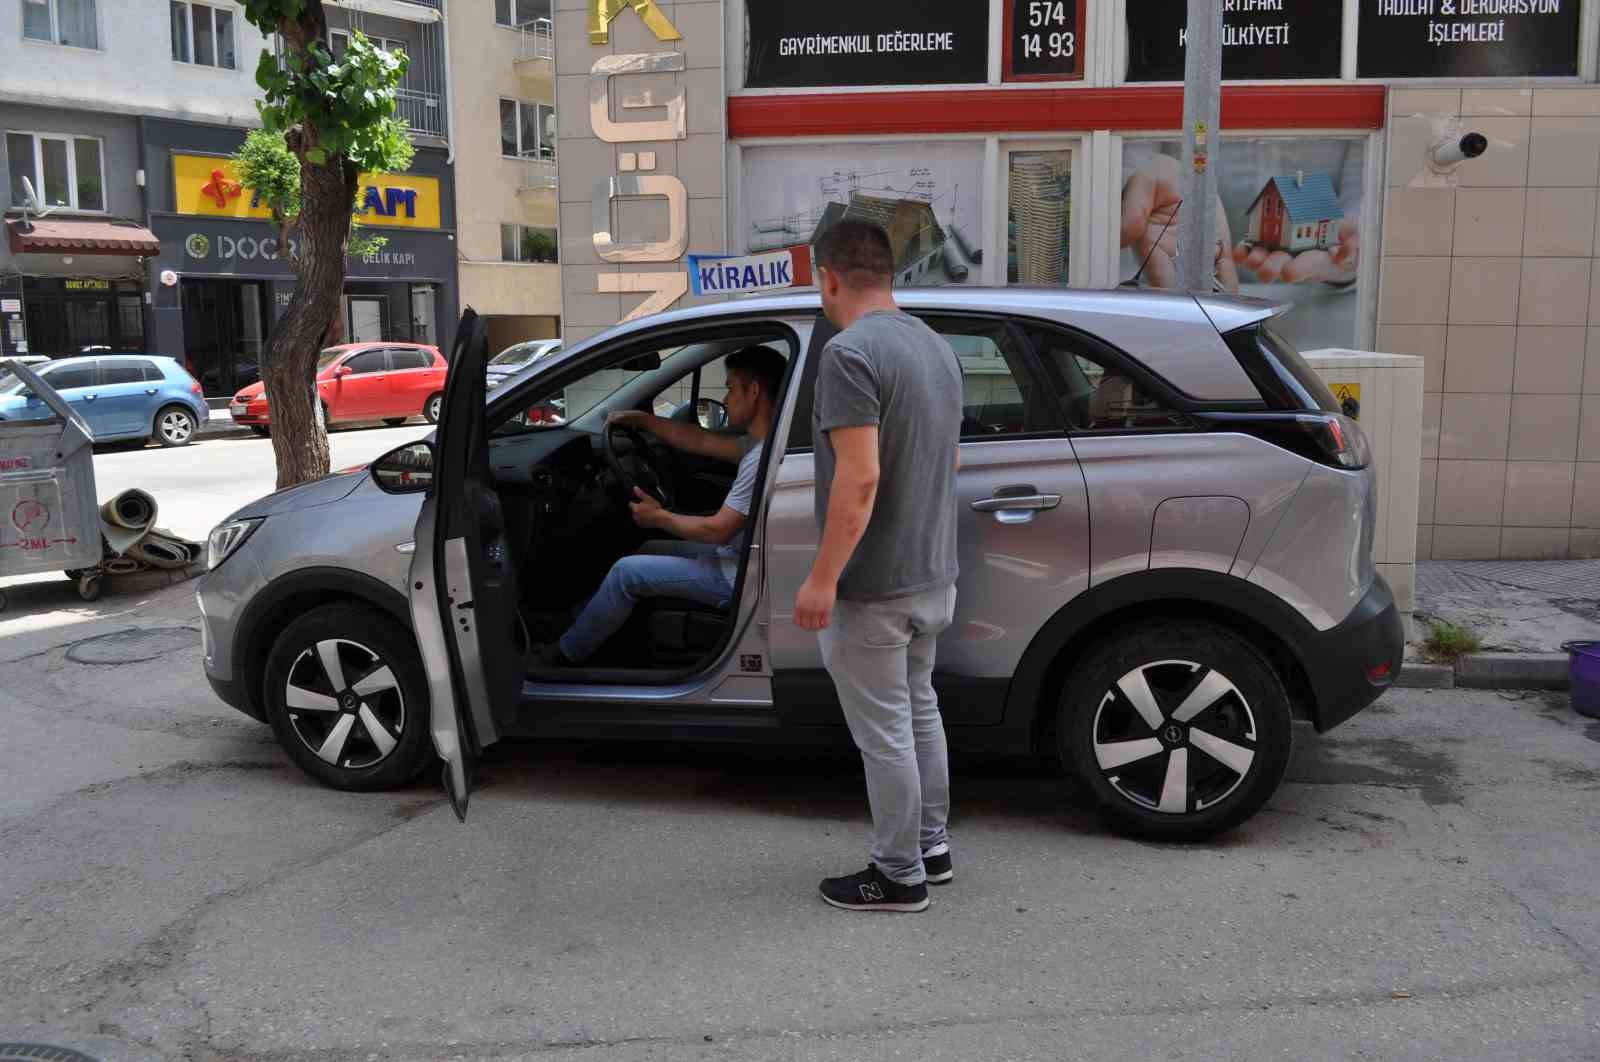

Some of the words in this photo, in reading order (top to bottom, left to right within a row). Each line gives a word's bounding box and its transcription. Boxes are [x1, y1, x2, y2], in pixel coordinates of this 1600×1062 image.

[1029, 1, 1066, 27] 574
[1440, 0, 1456, 15] &
[1460, 0, 1560, 15] DEKORASYON
[779, 33, 873, 56] GAYRİMENKUL
[877, 30, 953, 52] DEĞERLEME
[1021, 33, 1042, 58] 14
[1048, 31, 1075, 57] 93
[1221, 22, 1290, 46] ÜLKİYETİ
[1427, 20, 1505, 46] İŞLEMLERİ
[701, 260, 791, 290] KİRALIK
